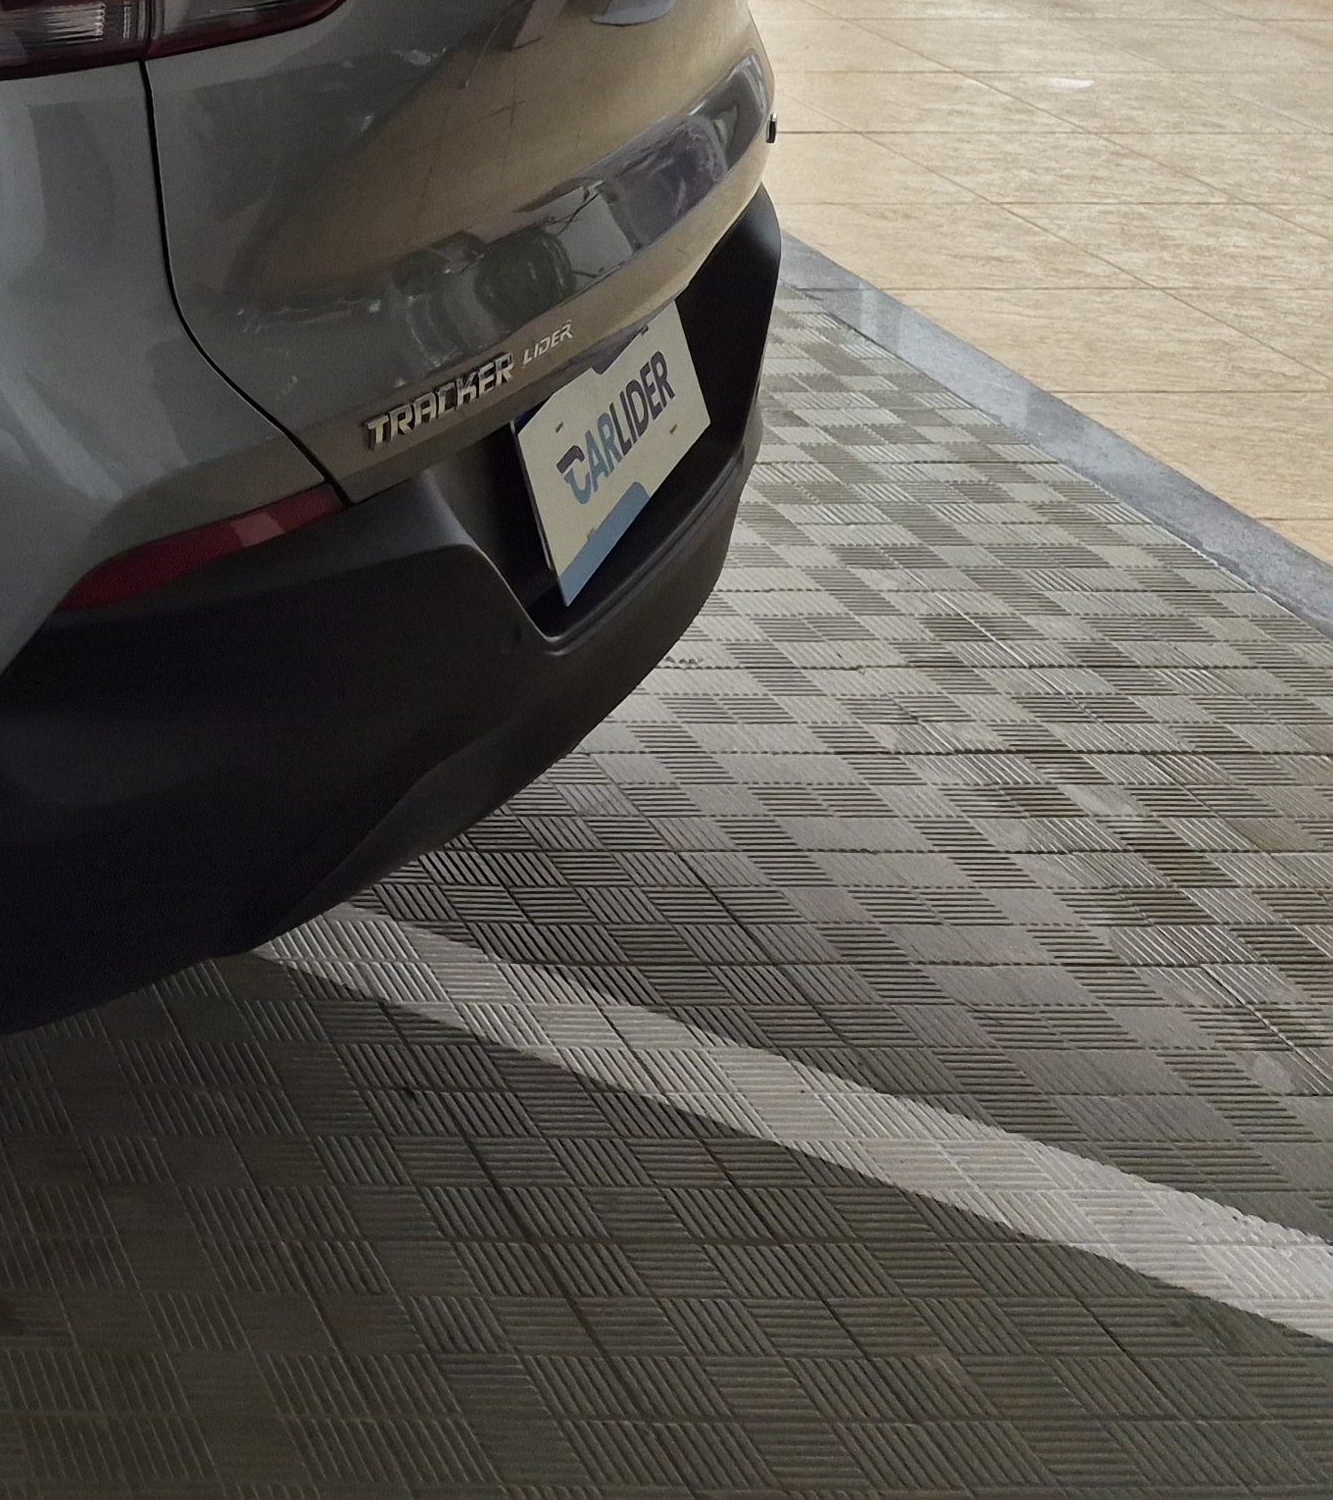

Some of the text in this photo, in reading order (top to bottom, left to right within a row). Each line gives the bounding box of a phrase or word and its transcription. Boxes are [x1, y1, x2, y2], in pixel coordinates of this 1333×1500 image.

[522, 320, 574, 367] LIDER
[364, 352, 515, 449] TRACKER
[556, 351, 676, 505] CARLIDER
